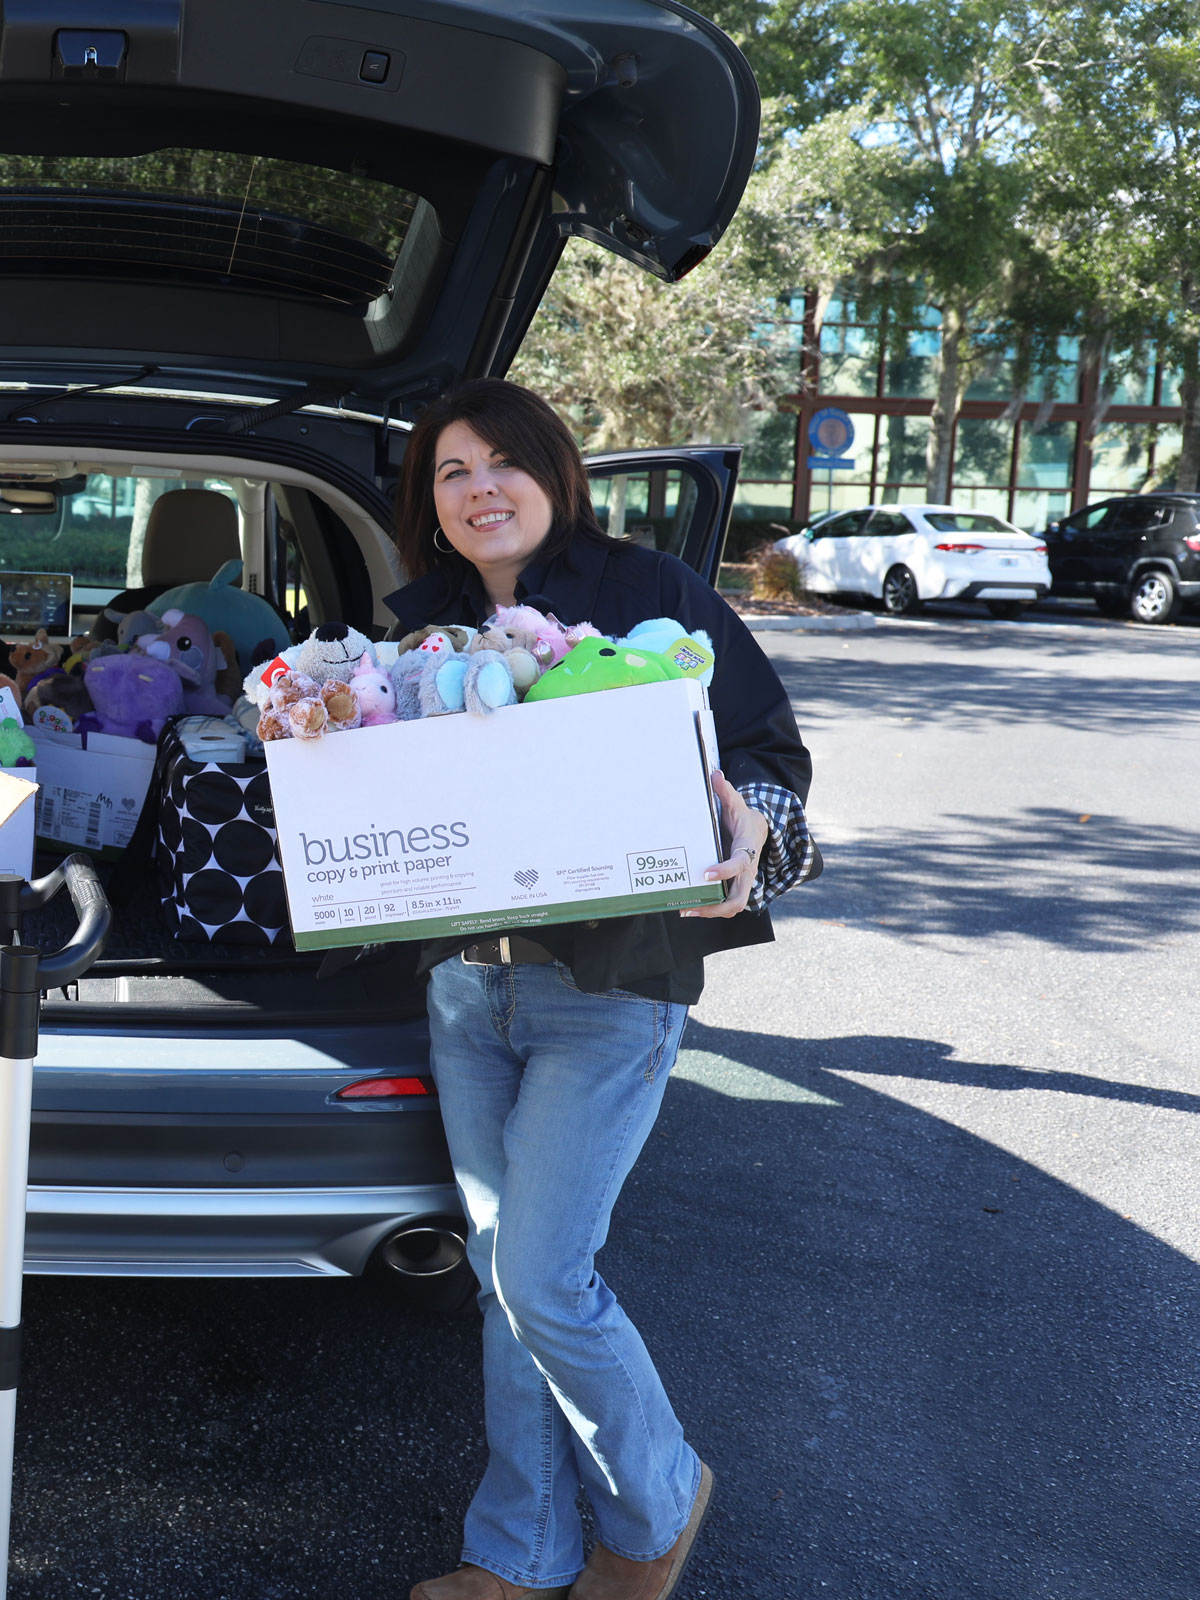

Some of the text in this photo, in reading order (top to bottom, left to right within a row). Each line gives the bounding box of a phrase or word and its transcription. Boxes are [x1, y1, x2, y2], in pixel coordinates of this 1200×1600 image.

[299, 821, 470, 866] business
[636, 855, 679, 871] 99.99%
[307, 855, 452, 884] copy & print paper
[567, 866, 590, 875] Certified
[591, 864, 614, 872] Sourcing
[430, 874, 450, 882] printing
[635, 876, 654, 887] NO
[311, 894, 334, 903] white
[511, 893, 528, 901] MADE
[384, 903, 395, 912] 92
[411, 900, 434, 909] 8.5in
[314, 909, 336, 920] 5000
[344, 908, 354, 917] 10
[364, 905, 375, 915] 20
